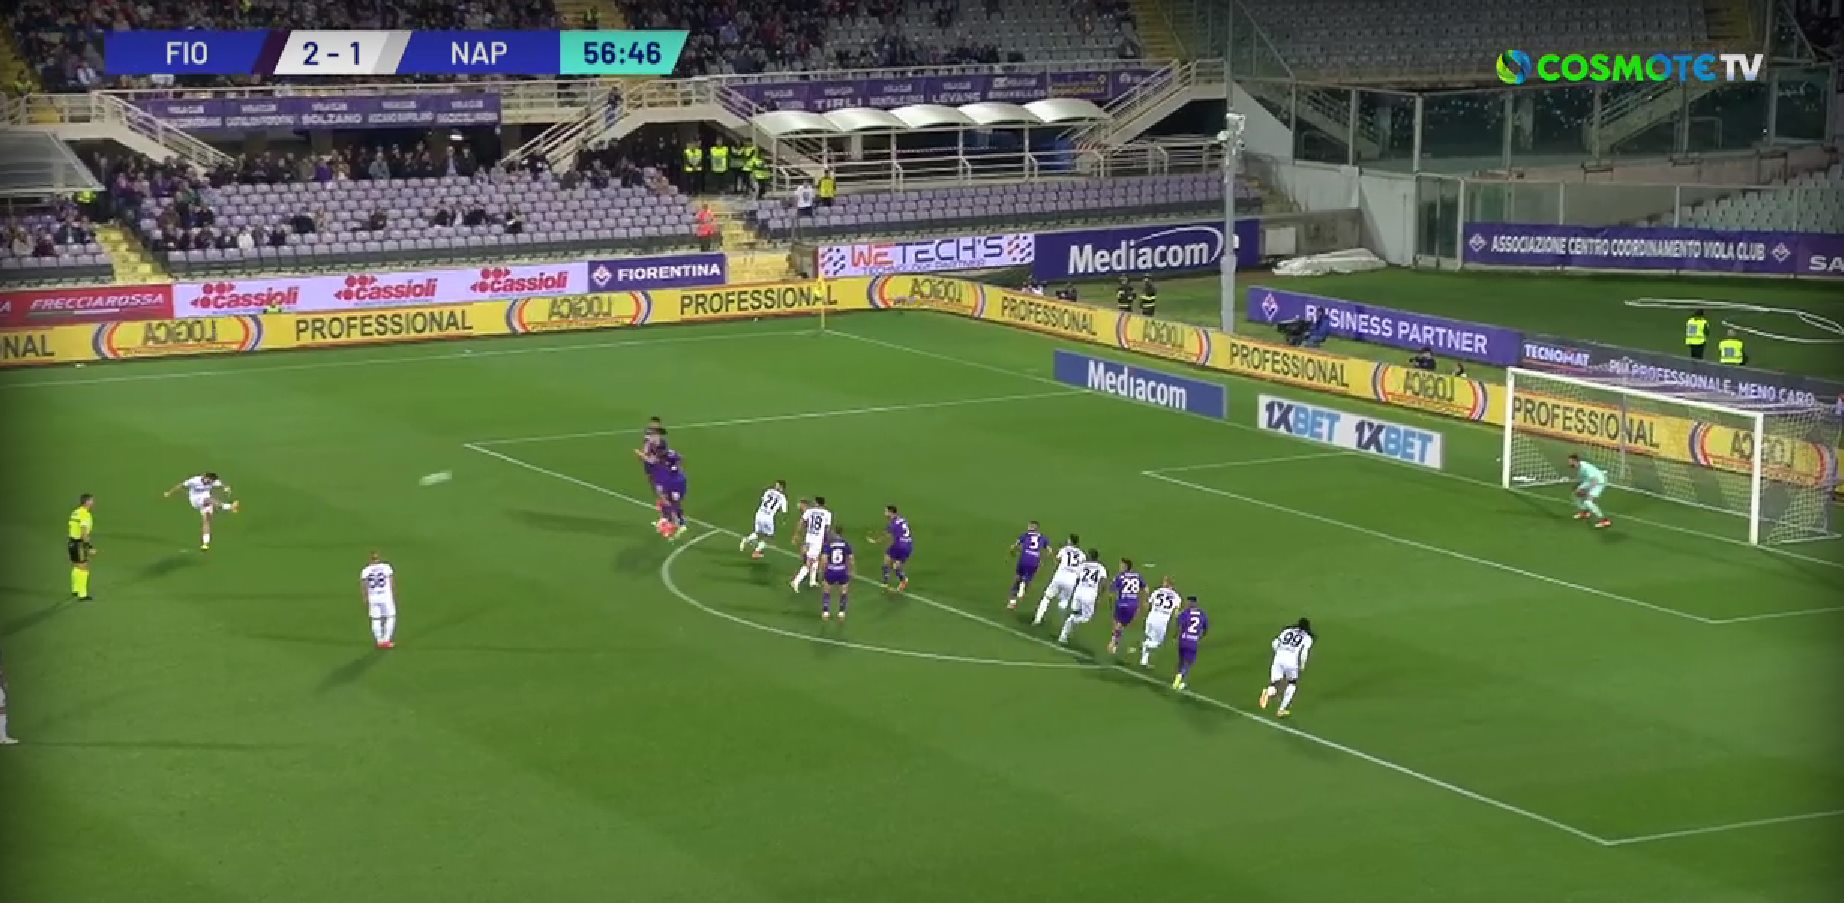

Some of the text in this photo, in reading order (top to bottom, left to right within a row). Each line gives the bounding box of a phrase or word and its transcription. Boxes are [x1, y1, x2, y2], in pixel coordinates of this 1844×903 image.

[1067, 239, 1209, 275] Mediacom
[1491, 235, 1767, 261] ASSOCIAZIONE CENTRO COORDINAMENTO VIOLA CLUB
[489, 270, 570, 294] cassioli
[617, 263, 721, 281] FIORENTINA
[212, 285, 299, 309] cassioli
[355, 277, 437, 301] cassioli
[680, 284, 838, 315] PROFESSIONAL
[29, 293, 165, 311] FRECCIAROSSA
[295, 309, 473, 342] PROFESSIONAL
[1001, 295, 1098, 337] PROFESSIONAL
[1397, 320, 1488, 355] PARTNER
[1229, 340, 1350, 388] PROFESSIONAL
[1523, 343, 1591, 367] TECNOMAT
[1738, 381, 1777, 402] MENO
[1778, 386, 1815, 407] CARO
[1087, 359, 1187, 411] Mediacom
[1264, 399, 1434, 463] 1XBET 1XBET
[1512, 395, 1660, 450] PROFESSIONAL
[809, 513, 823, 531] 18
[831, 548, 844, 564] 6
[1082, 568, 1099, 585] 24
[1122, 577, 1140, 594] 28
[1154, 593, 1173, 610] 55
[1188, 616, 1200, 634] 2
[1282, 631, 1304, 648] 99
